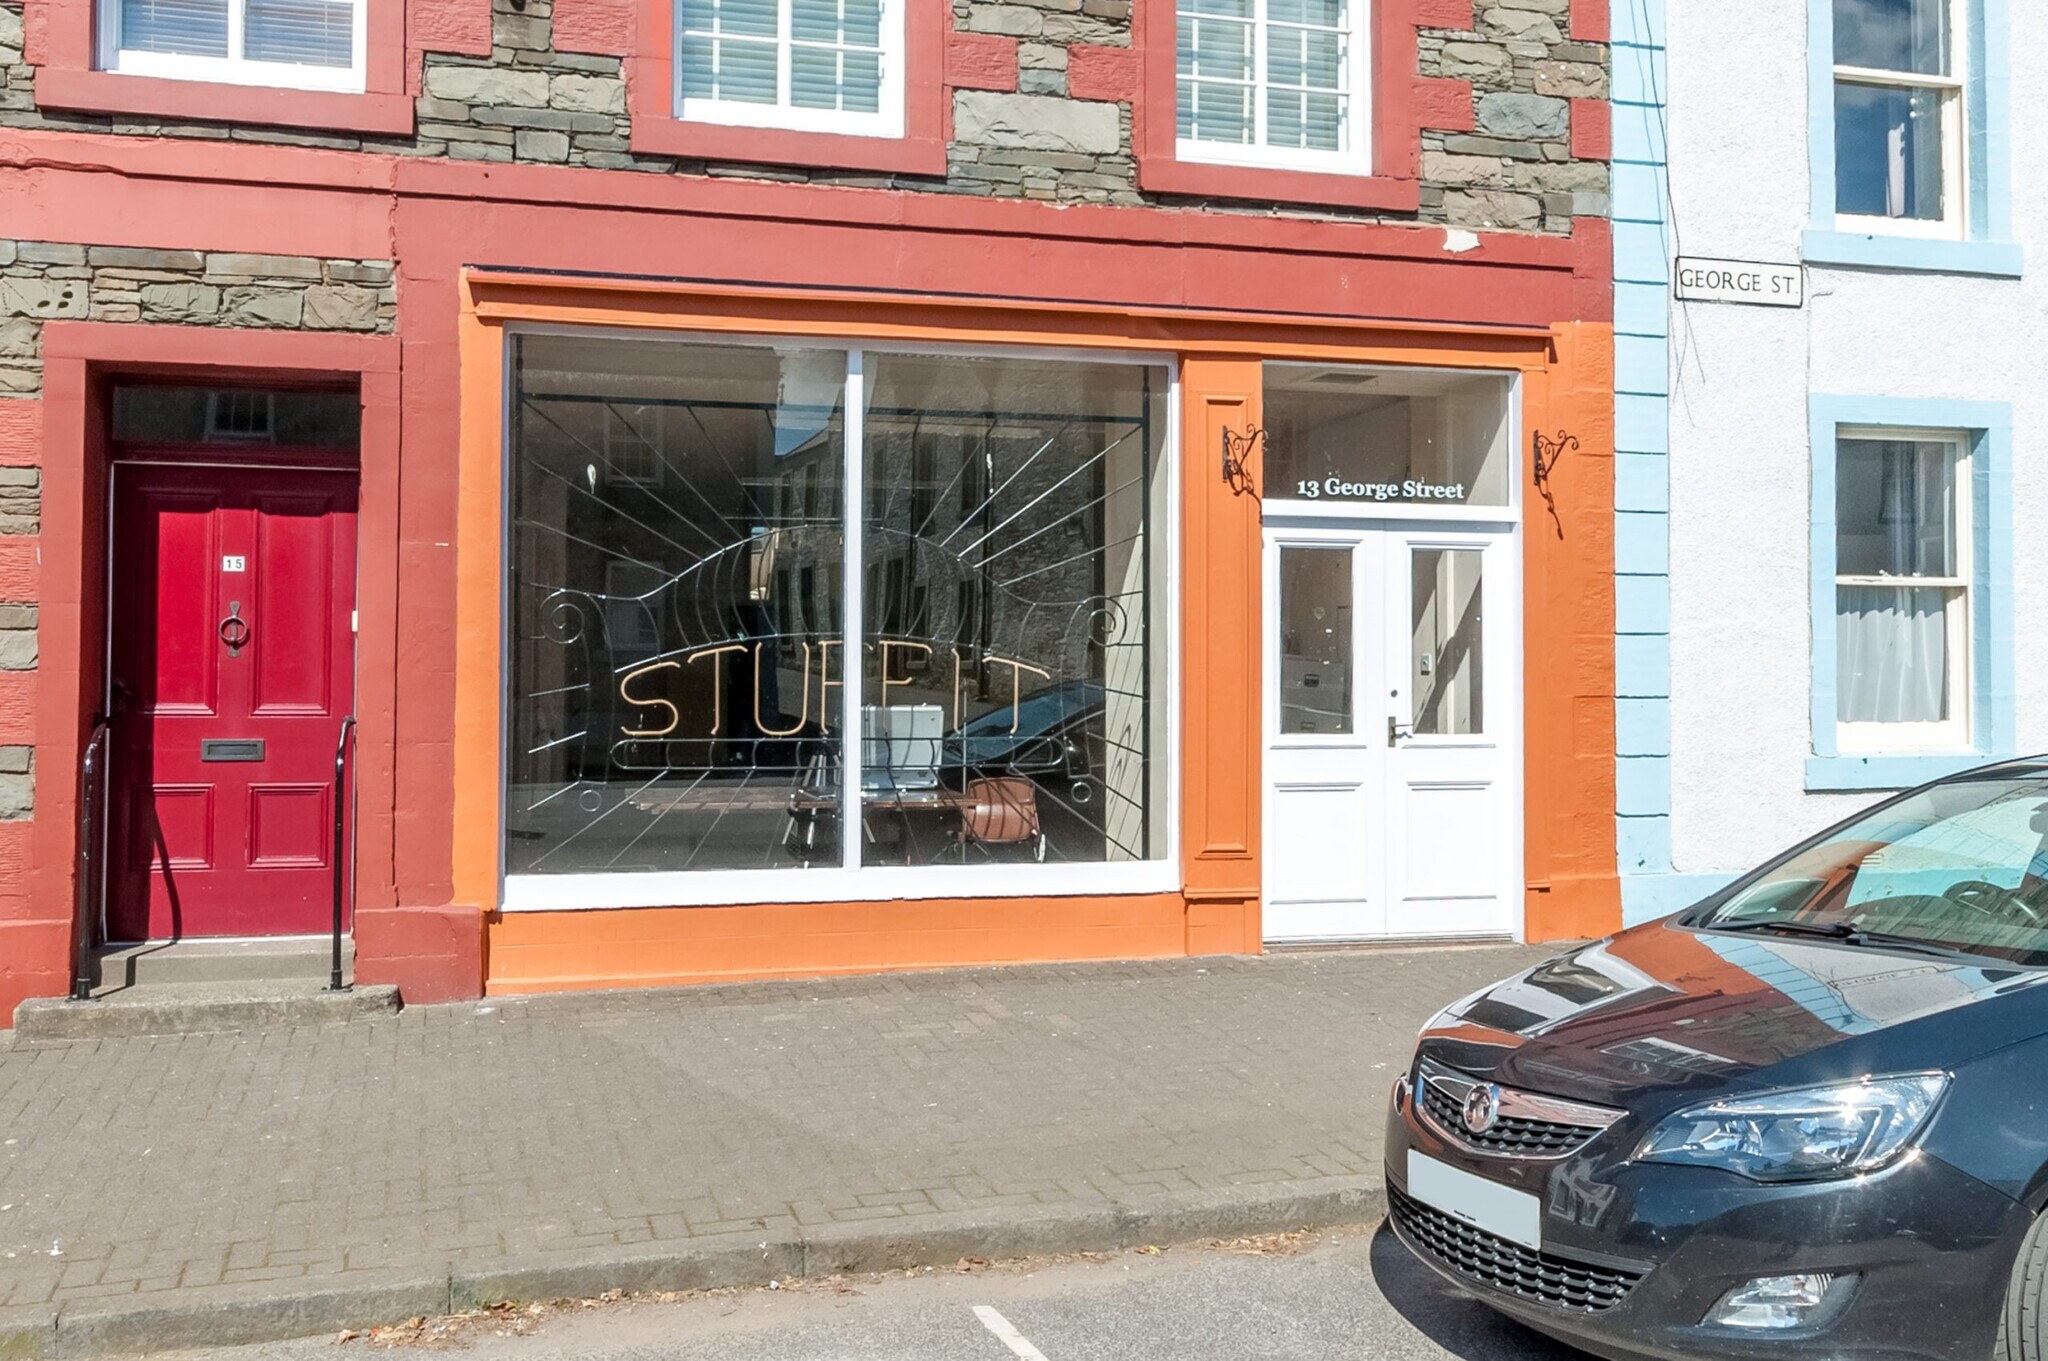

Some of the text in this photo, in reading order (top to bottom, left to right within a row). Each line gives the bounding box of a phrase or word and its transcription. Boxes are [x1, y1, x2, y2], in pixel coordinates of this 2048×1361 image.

[1680, 268, 1761, 292] GEORGE
[1297, 477, 1465, 500] 13 George Street
[226, 558, 243, 569] 15
